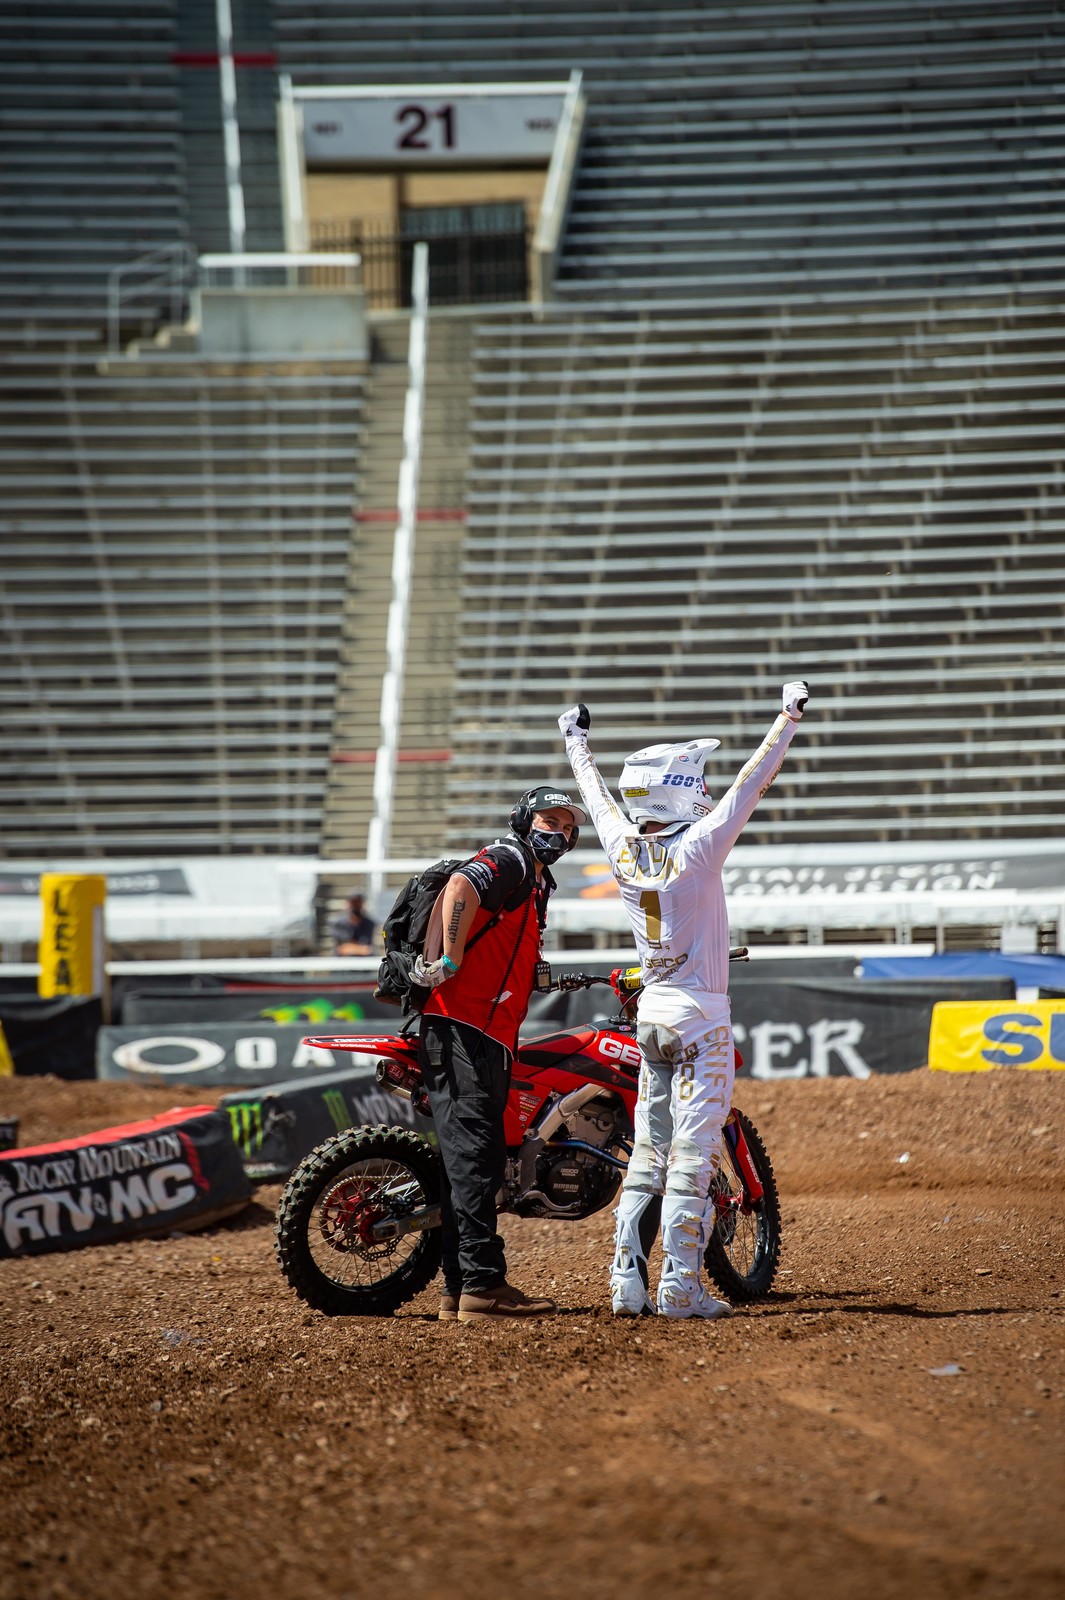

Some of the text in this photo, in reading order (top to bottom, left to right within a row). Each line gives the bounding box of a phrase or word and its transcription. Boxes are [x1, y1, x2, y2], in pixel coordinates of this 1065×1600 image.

[396, 104, 456, 149] 21
[662, 773, 704, 790] 100%
[639, 890, 663, 949] 1
[645, 952, 689, 969] GEICO
[732, 1019, 872, 1081] ER
[980, 1013, 1065, 1065] S
[703, 1026, 730, 1108] SHIFT
[12, 1132, 183, 1193] ROCKY MOUNTAIN
